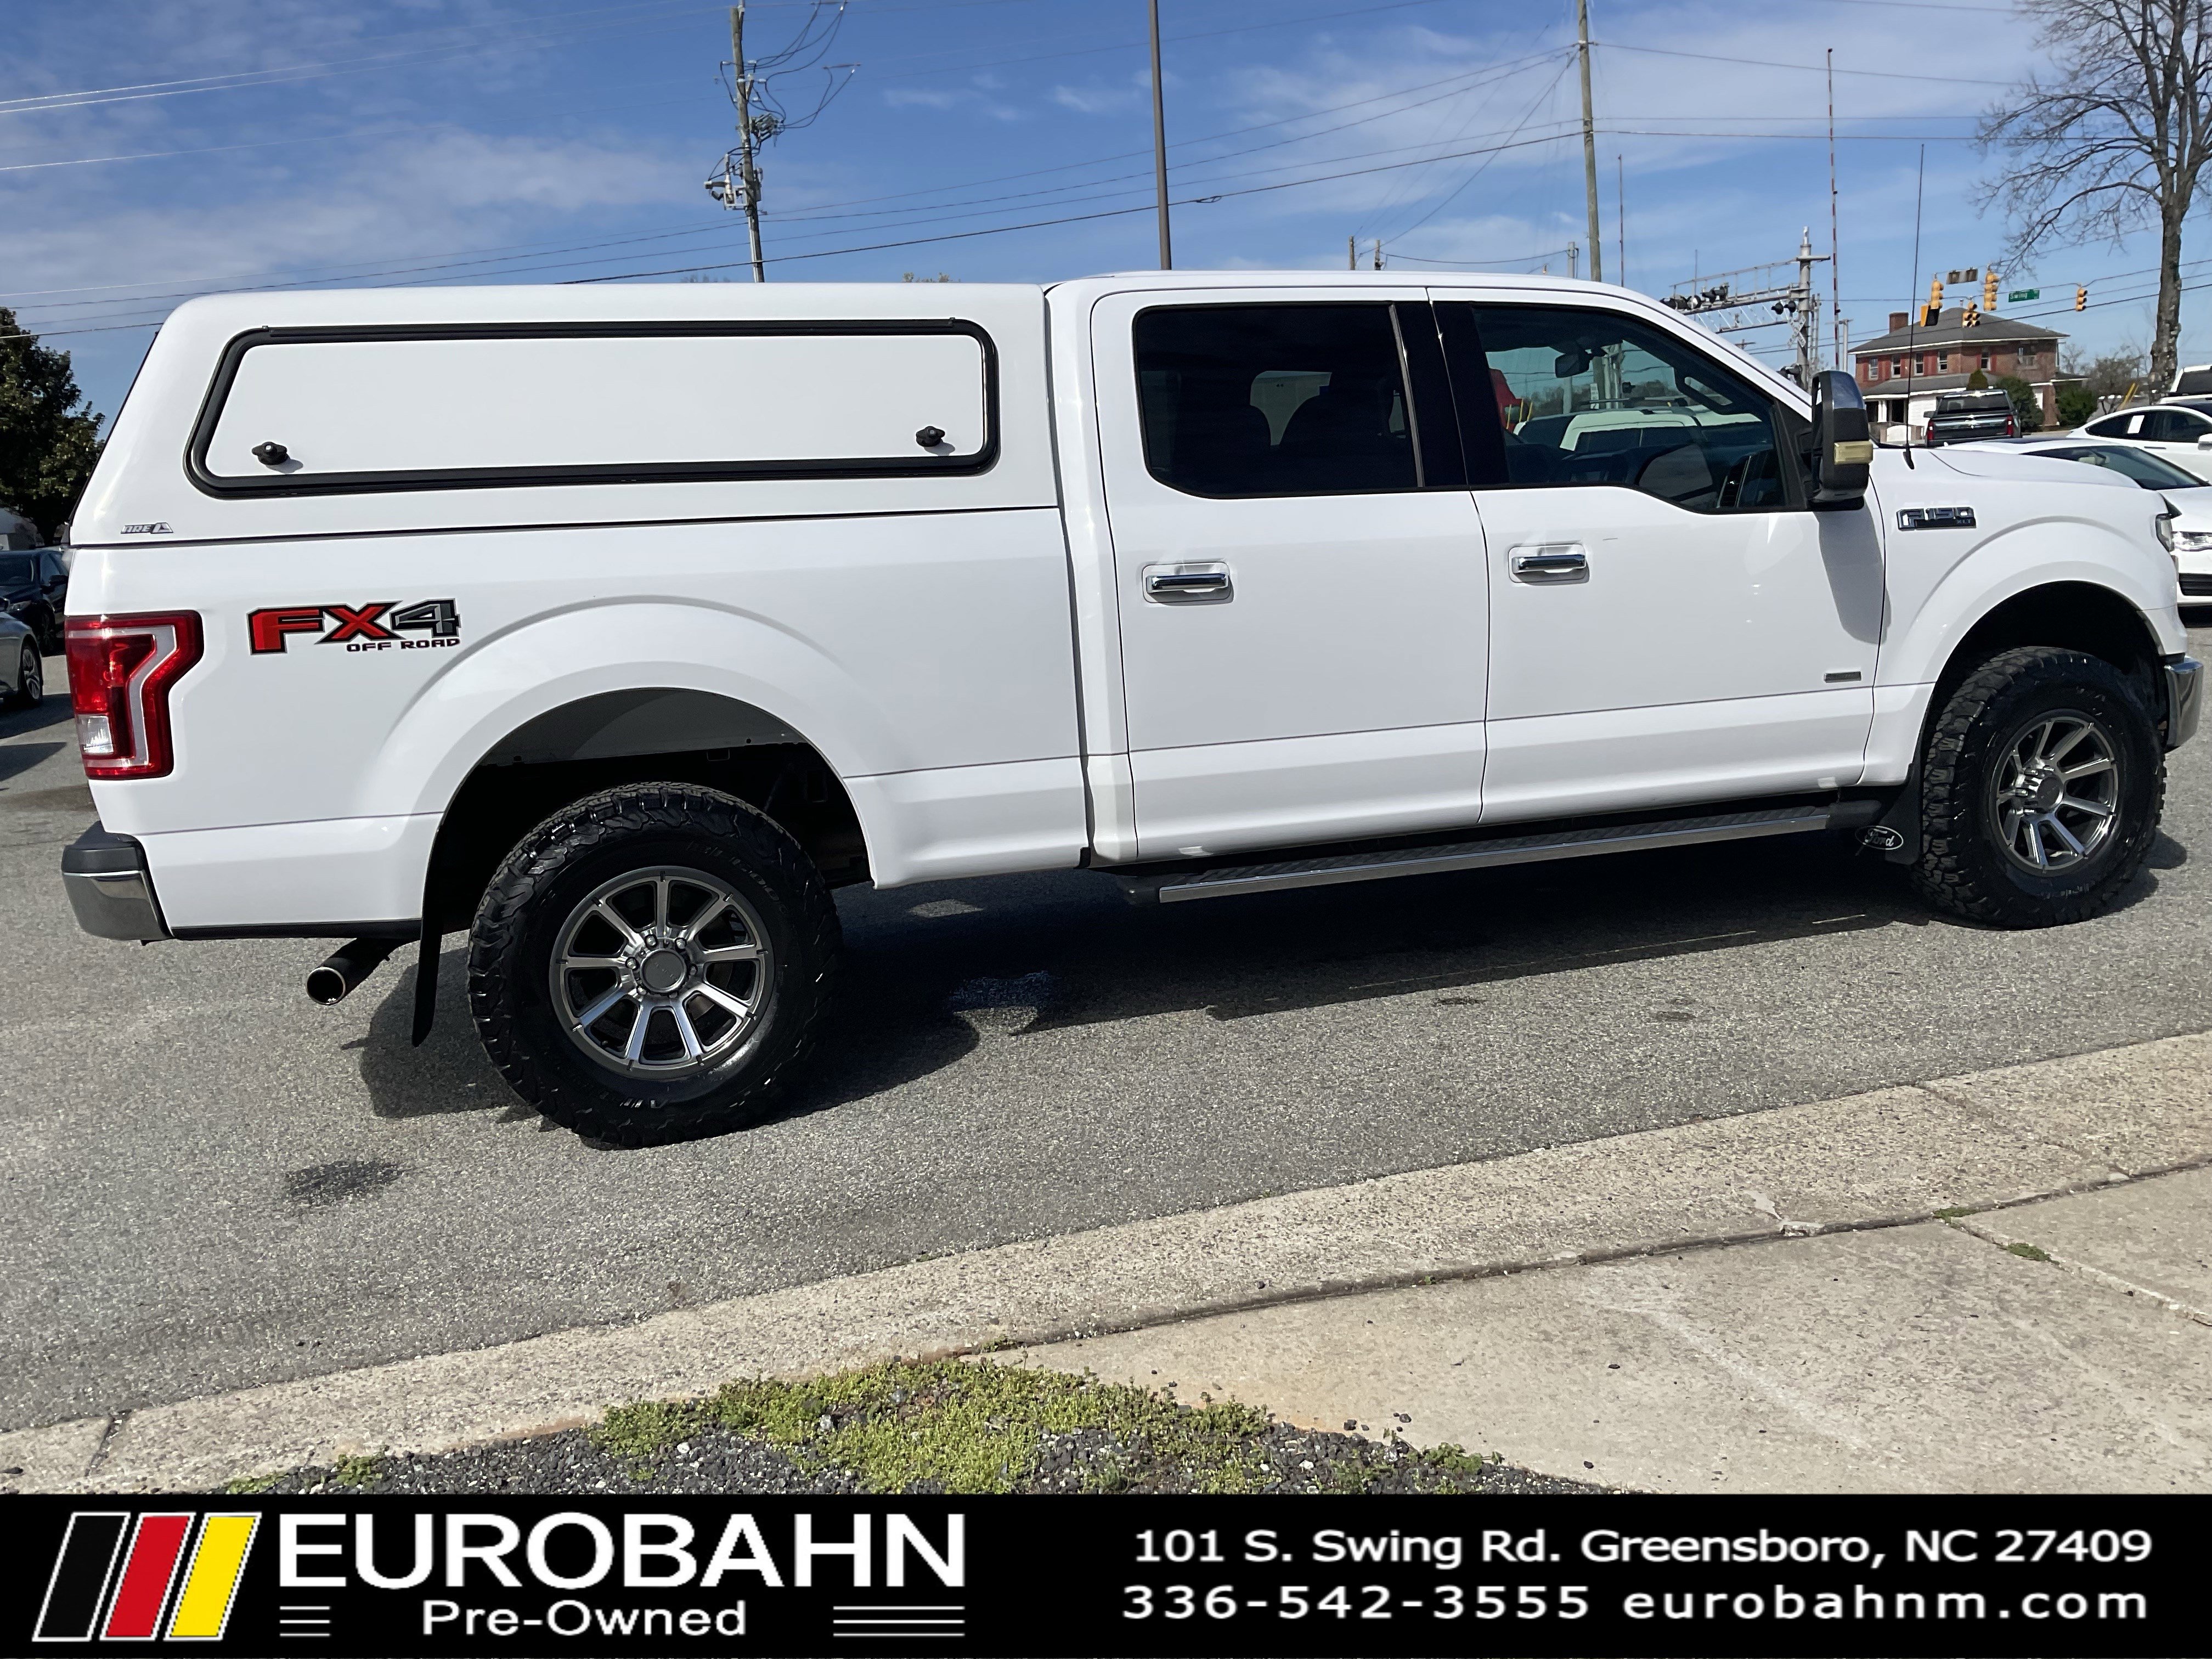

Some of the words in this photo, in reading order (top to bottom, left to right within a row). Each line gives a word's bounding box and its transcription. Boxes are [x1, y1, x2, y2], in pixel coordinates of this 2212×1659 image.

[246, 597, 461, 656] FX4
[346, 642, 392, 652] OFF
[400, 638, 461, 650] ROAD
